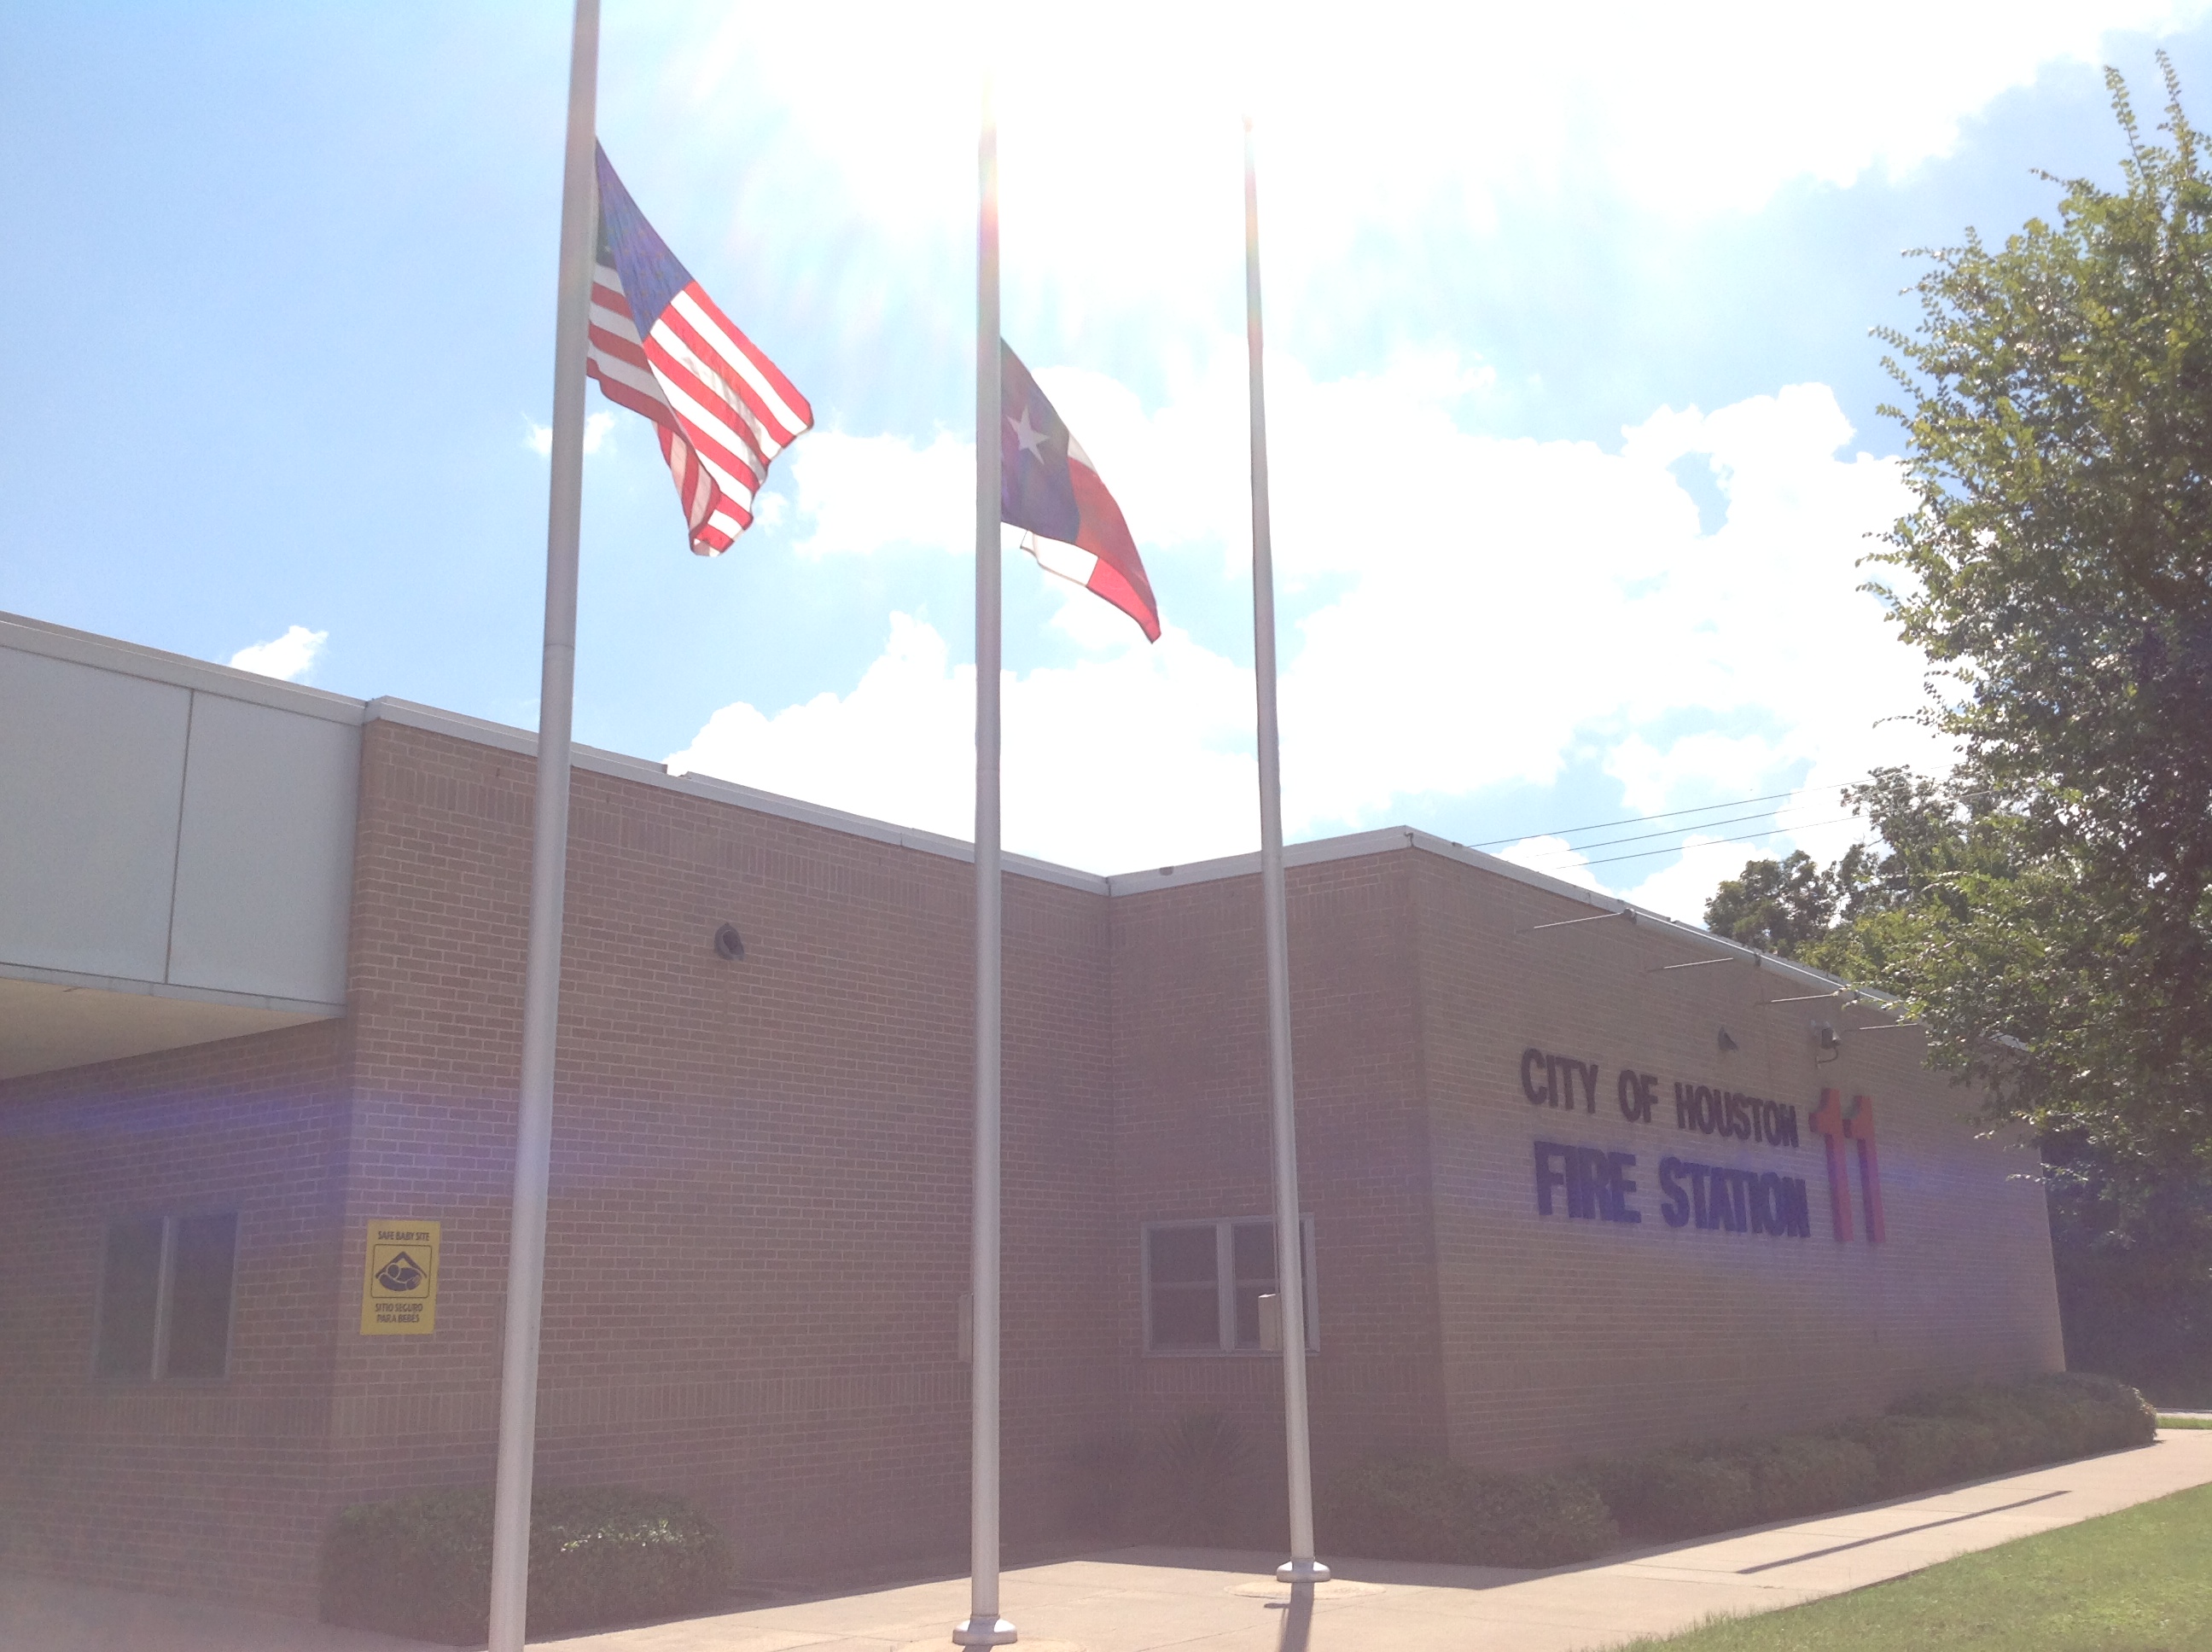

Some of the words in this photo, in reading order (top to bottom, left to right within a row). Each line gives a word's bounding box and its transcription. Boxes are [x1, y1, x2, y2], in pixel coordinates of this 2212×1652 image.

[1521, 1048, 1598, 1114] CITY
[1618, 1069, 1658, 1123] OF
[1674, 1081, 1800, 1149] HOUSTON
[1534, 1140, 1642, 1224] FIRE
[1659, 1156, 1811, 1239] STATION
[1808, 1087, 1886, 1243] 11
[378, 1230, 394, 1240] SAFE
[395, 1231, 414, 1241] BABY
[415, 1232, 430, 1242] SITE
[375, 1303, 393, 1312] SITIO
[394, 1303, 423, 1312] SEGURO
[376, 1314, 397, 1323] PARA
